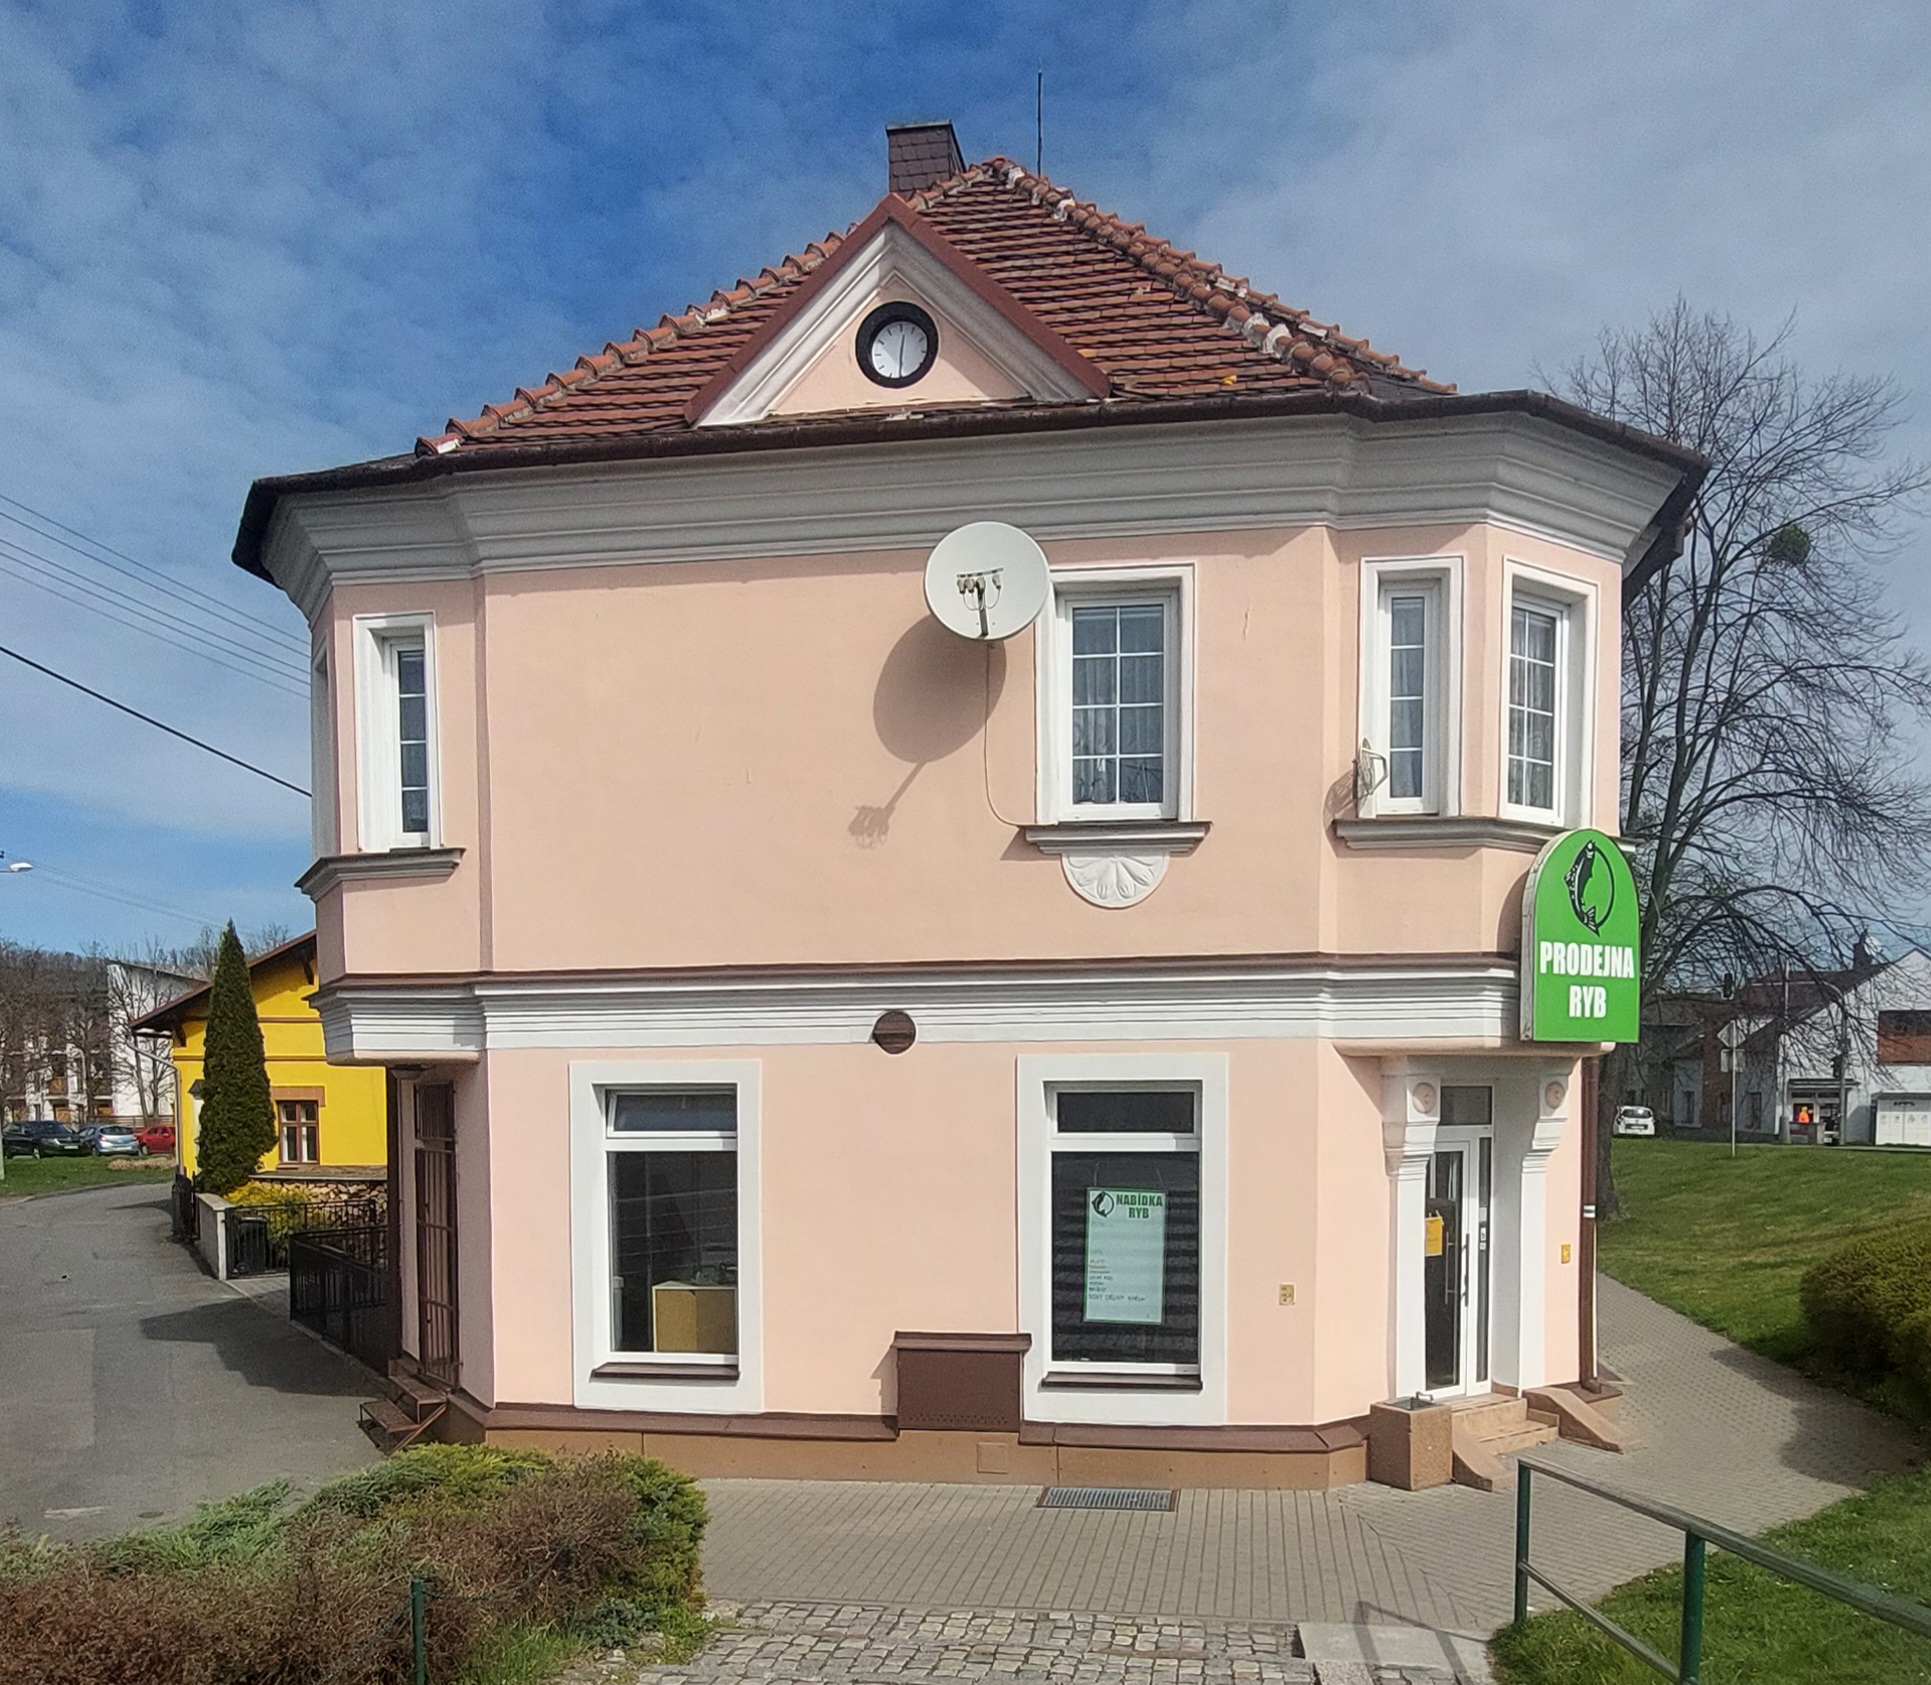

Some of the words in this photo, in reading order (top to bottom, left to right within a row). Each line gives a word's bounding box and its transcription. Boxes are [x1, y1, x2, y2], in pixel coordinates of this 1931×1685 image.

[1540, 941, 1635, 978] PRODEJNA
[1569, 985, 1607, 1018] RYB
[1116, 1193, 1163, 1207] NABÍDKA
[1129, 1207, 1149, 1219] RYB
